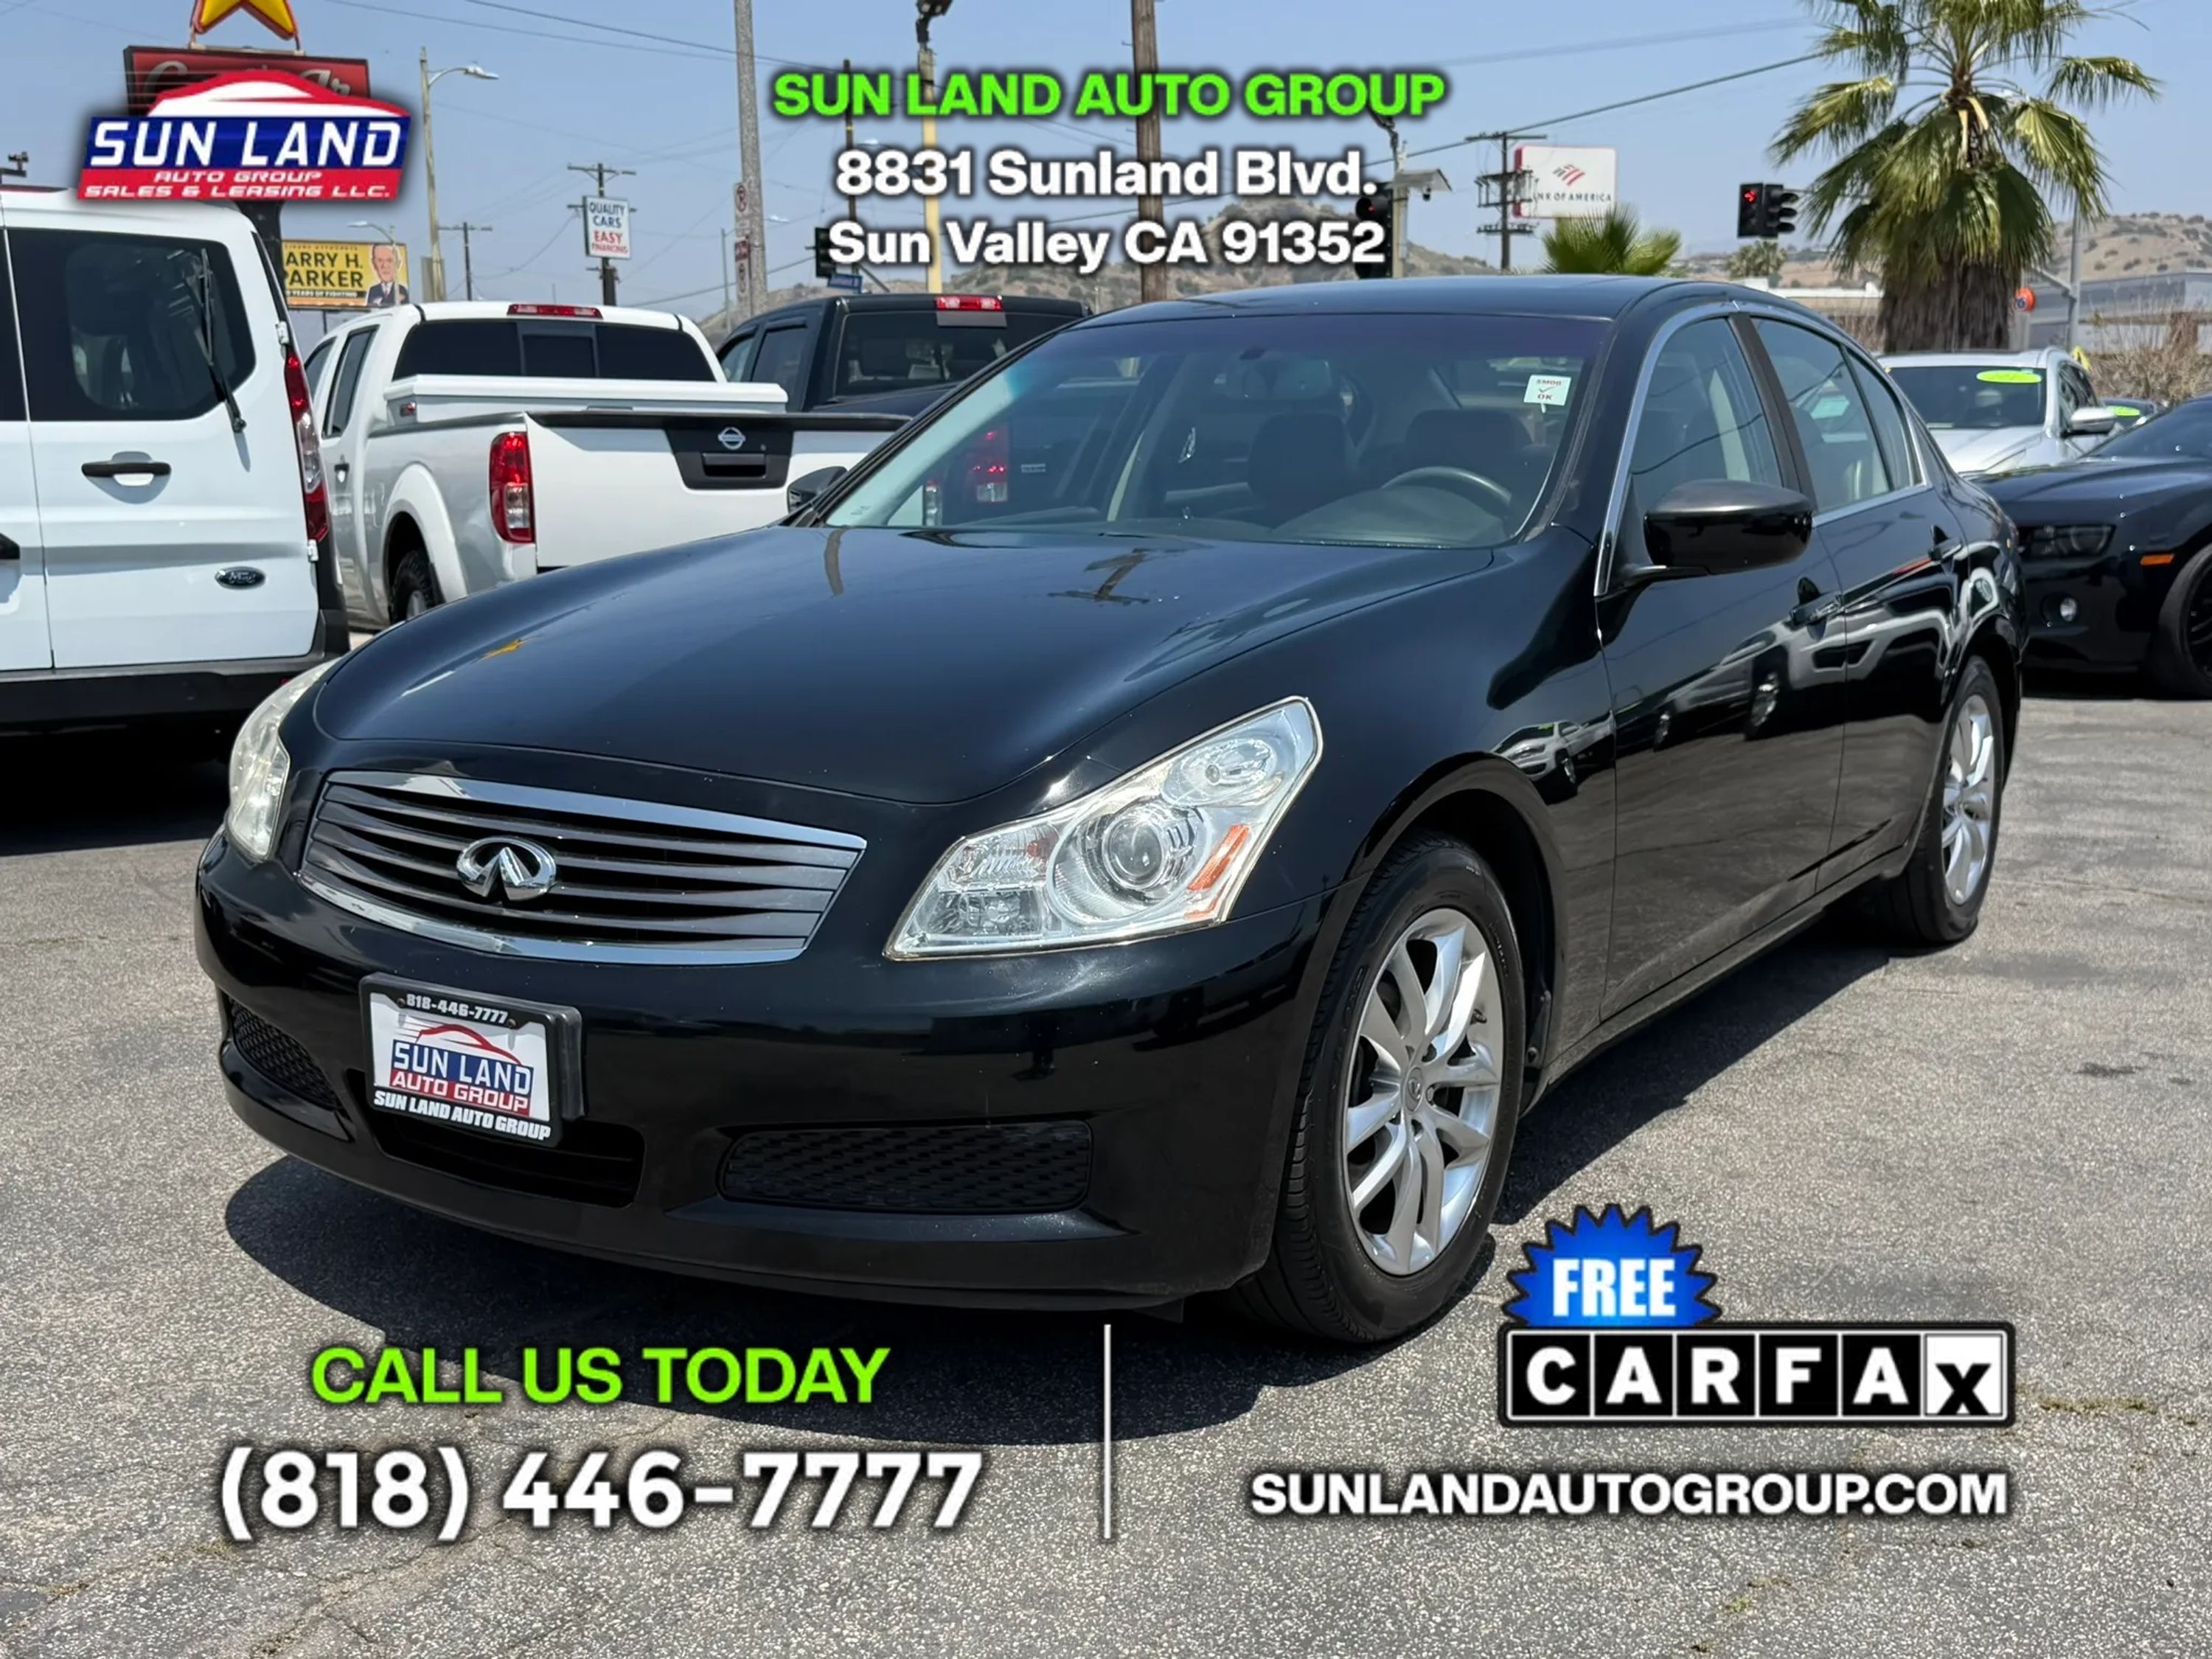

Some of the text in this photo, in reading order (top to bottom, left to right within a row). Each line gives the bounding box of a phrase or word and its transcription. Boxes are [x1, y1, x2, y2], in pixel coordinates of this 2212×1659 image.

[1568, 192, 1612, 201] AMERICA
[589, 202, 626, 217] QUALITY
[593, 215, 622, 229] CARS
[594, 230, 622, 245] EASY
[285, 251, 338, 268] ARRY
[285, 269, 364, 288] ARKER
[406, 994, 509, 1024] 818-446-7777
[394, 1043, 532, 1096] SUN LAND
[392, 1071, 529, 1112] AUTO GROUP
[373, 1091, 552, 1141] SUN LAND AUTO GROUP
